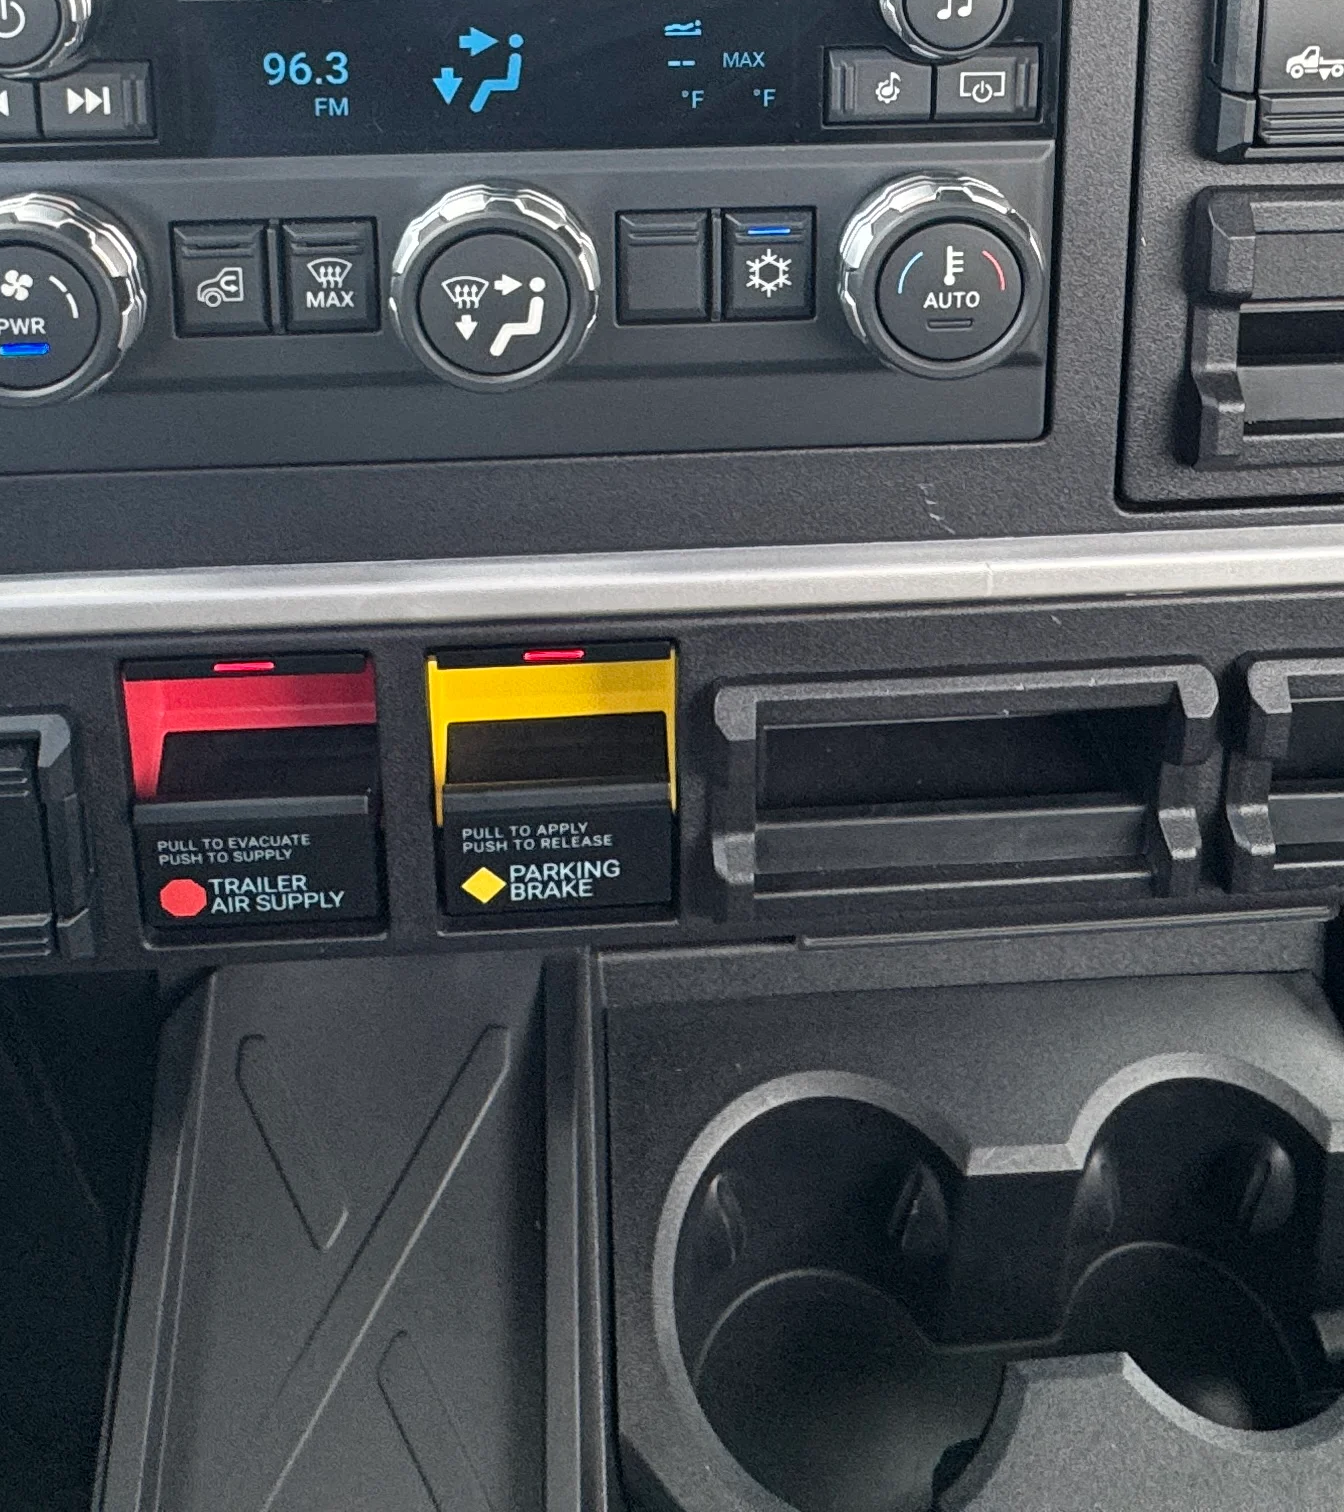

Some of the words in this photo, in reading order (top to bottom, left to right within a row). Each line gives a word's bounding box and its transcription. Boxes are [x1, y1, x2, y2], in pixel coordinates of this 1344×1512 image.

[263, 52, 349, 86] 96.3
[722, 51, 765, 68] MAX
[314, 97, 349, 117] FM
[306, 290, 355, 308] MAX
[923, 290, 981, 309] AUTO
[463, 827, 504, 840] PULL
[509, 824, 531, 837] TO
[536, 822, 588, 836] APPLY
[157, 839, 198, 853] PULL
[202, 838, 224, 851] TO
[228, 834, 310, 849] EVACUATE
[462, 840, 508, 854] PUSH
[513, 839, 536, 851] TO
[540, 834, 613, 849] RELEASE
[158, 852, 203, 866] PUSH
[207, 851, 229, 863] TO
[233, 849, 293, 863] SUPPLY
[509, 859, 621, 883] PARKING
[208, 874, 308, 895] TRAILER
[510, 878, 594, 901] BRAKE
[210, 895, 251, 914] AIR
[256, 890, 345, 912] SUPPLY
